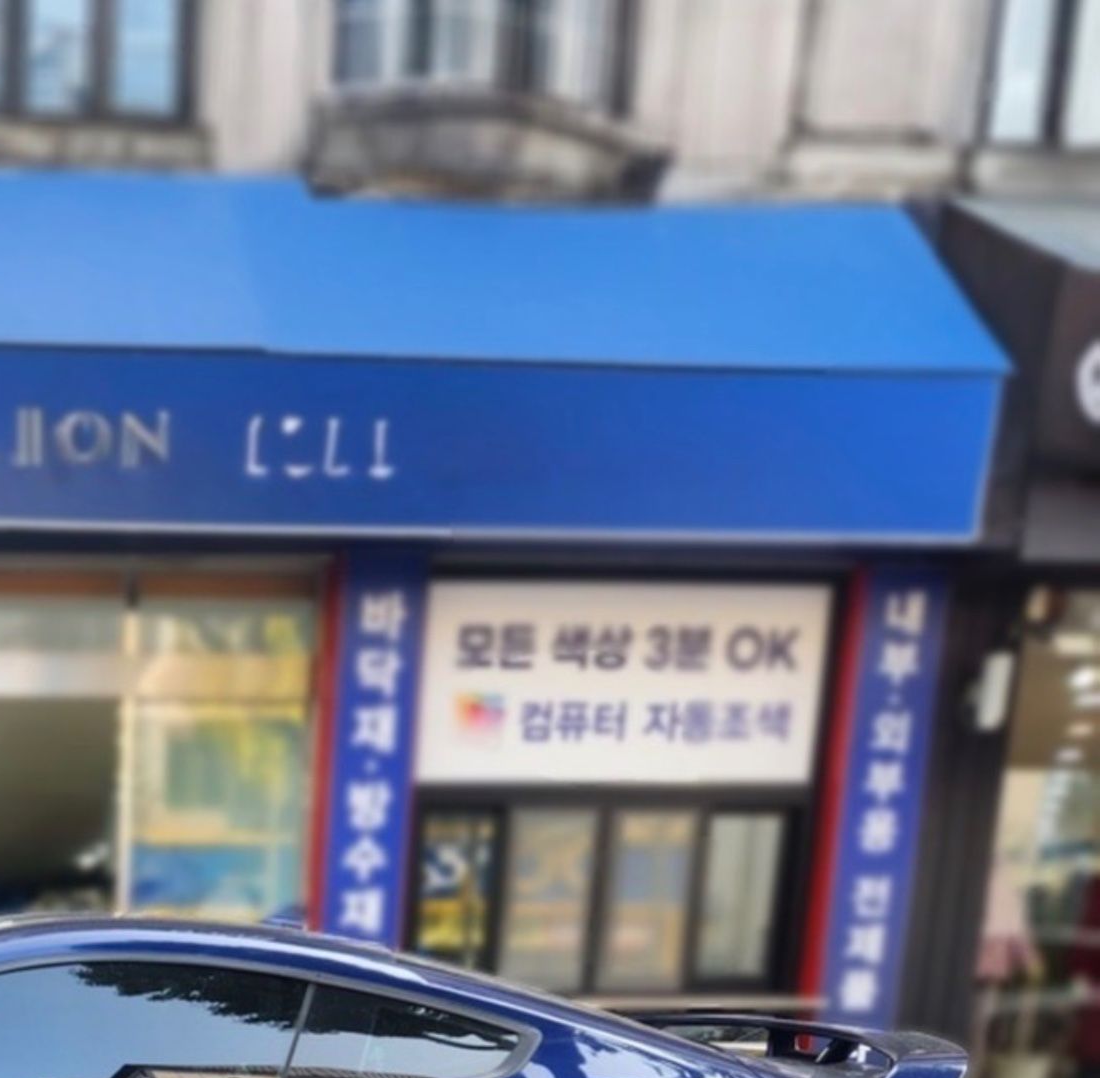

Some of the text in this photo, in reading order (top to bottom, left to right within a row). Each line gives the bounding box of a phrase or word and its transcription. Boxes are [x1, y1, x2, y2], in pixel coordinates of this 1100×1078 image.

[456, 623, 799, 672] 모든 색상 3분 OK
[520, 702, 793, 743] 컴퓨터 자동조색
